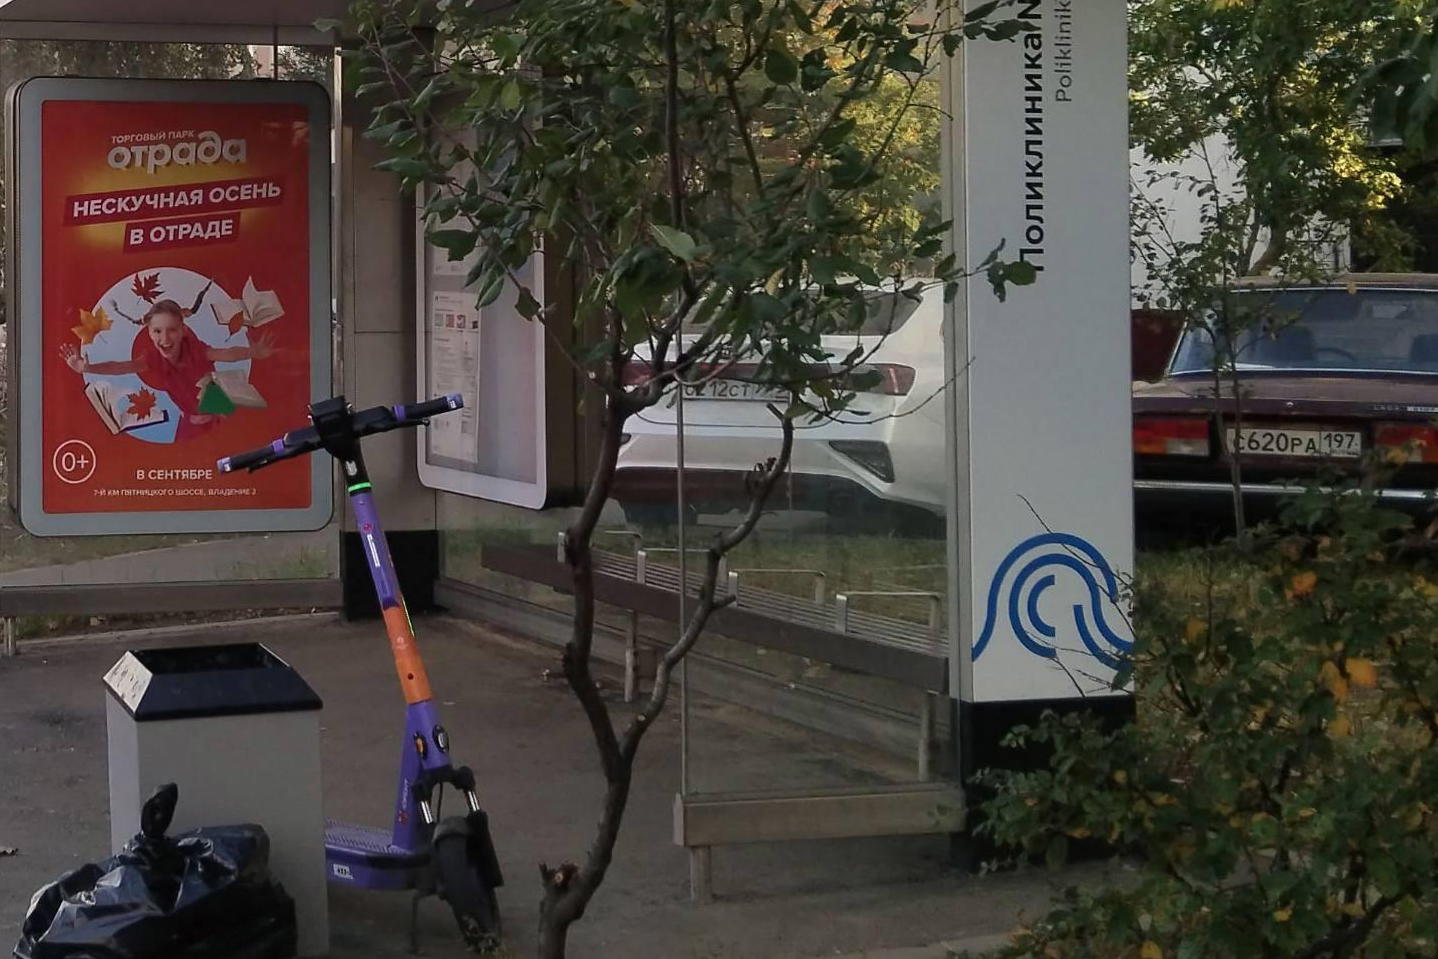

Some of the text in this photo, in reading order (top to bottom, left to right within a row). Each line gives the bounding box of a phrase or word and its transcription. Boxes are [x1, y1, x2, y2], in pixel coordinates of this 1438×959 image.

[111, 130, 195, 144] ТОРГОВЫЙ ПАРК
[1019, 33, 1044, 271] Поликлиника
[73, 182, 281, 218] НЕСКУЧНАЯ ОСЕНЬ
[130, 219, 233, 245] В ОТРАДЕ
[1323, 432, 1355, 449] 197
[62, 452, 89, 472] 0+
[136, 469, 212, 480] В СЕНТЯБРЕ
[121, 488, 174, 497] ПЯТНИЦКОГО
[208, 488, 250, 497] ВЛАДЕНИЕ
